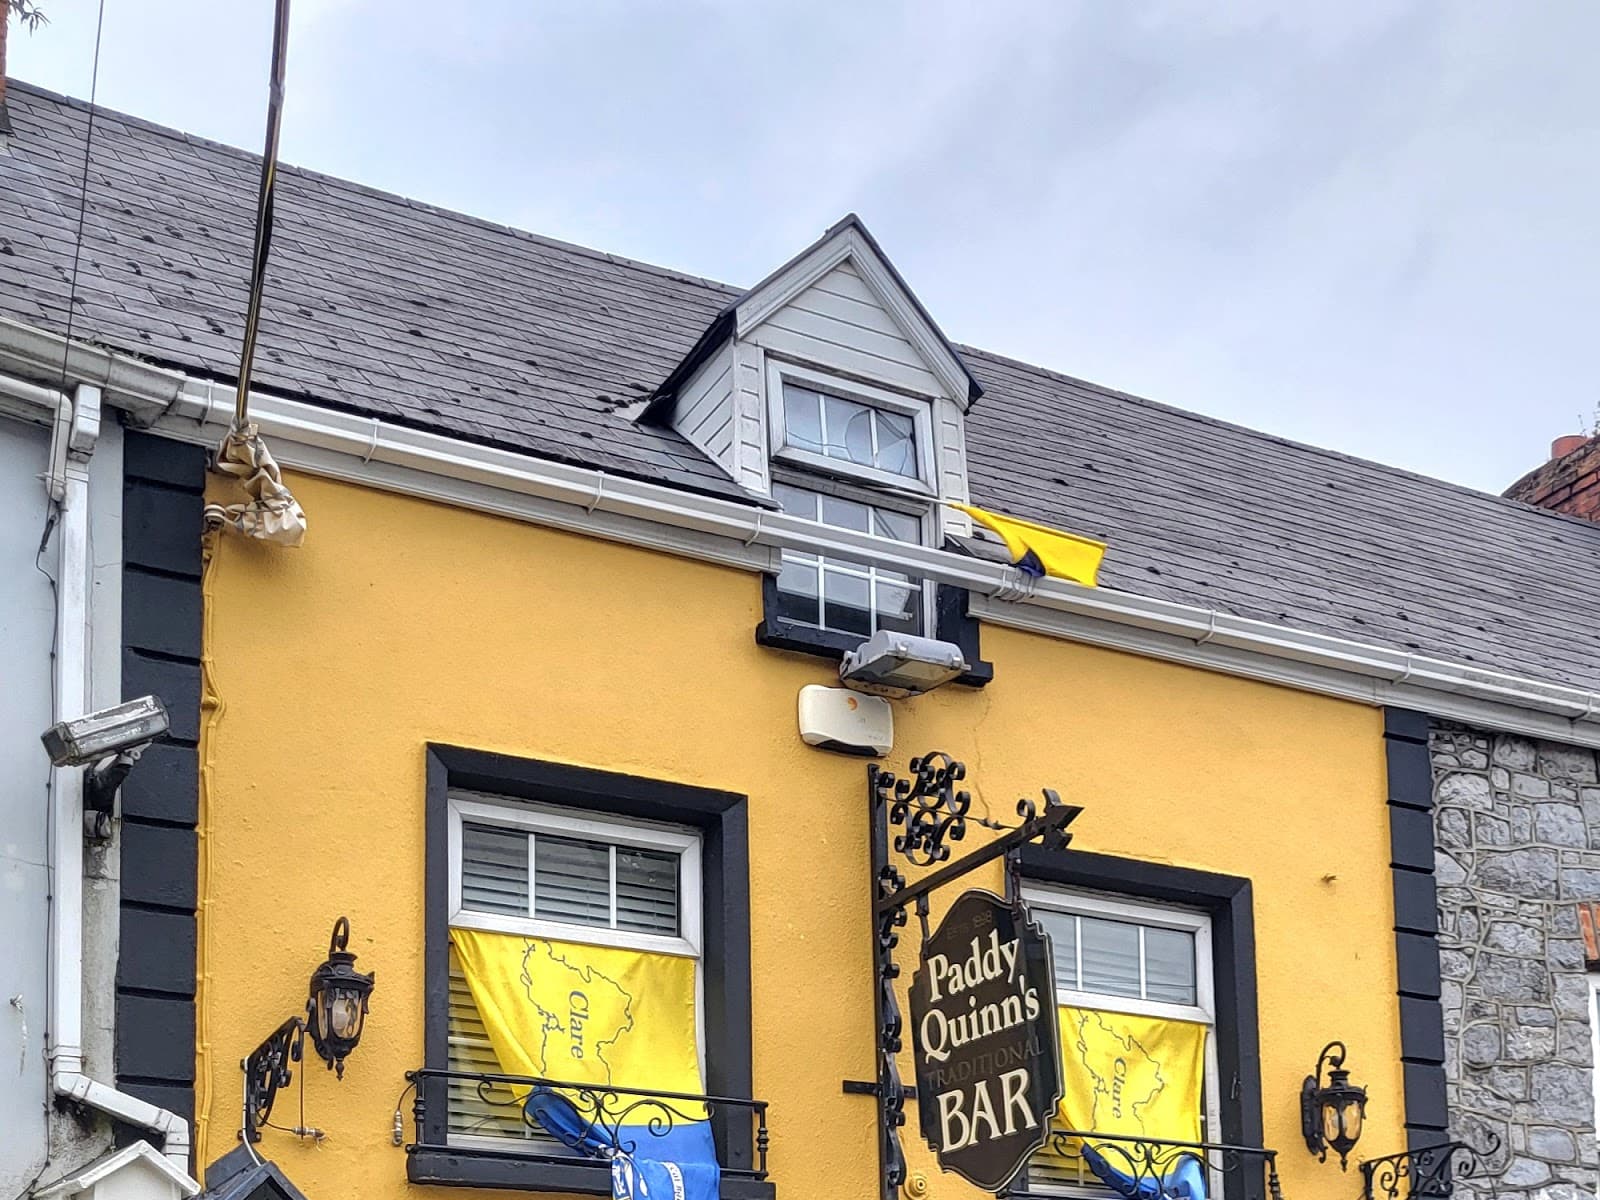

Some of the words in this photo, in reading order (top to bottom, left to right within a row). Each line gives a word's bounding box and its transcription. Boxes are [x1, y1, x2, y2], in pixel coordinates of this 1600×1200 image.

[927, 928, 1020, 1003] Paddy
[567, 989, 590, 1061] Clare
[920, 975, 1040, 1064] Quinn's
[923, 1036, 1045, 1090] TRADITIONAL
[1111, 1057, 1128, 1120] Clare
[936, 1067, 1039, 1154] BAR
